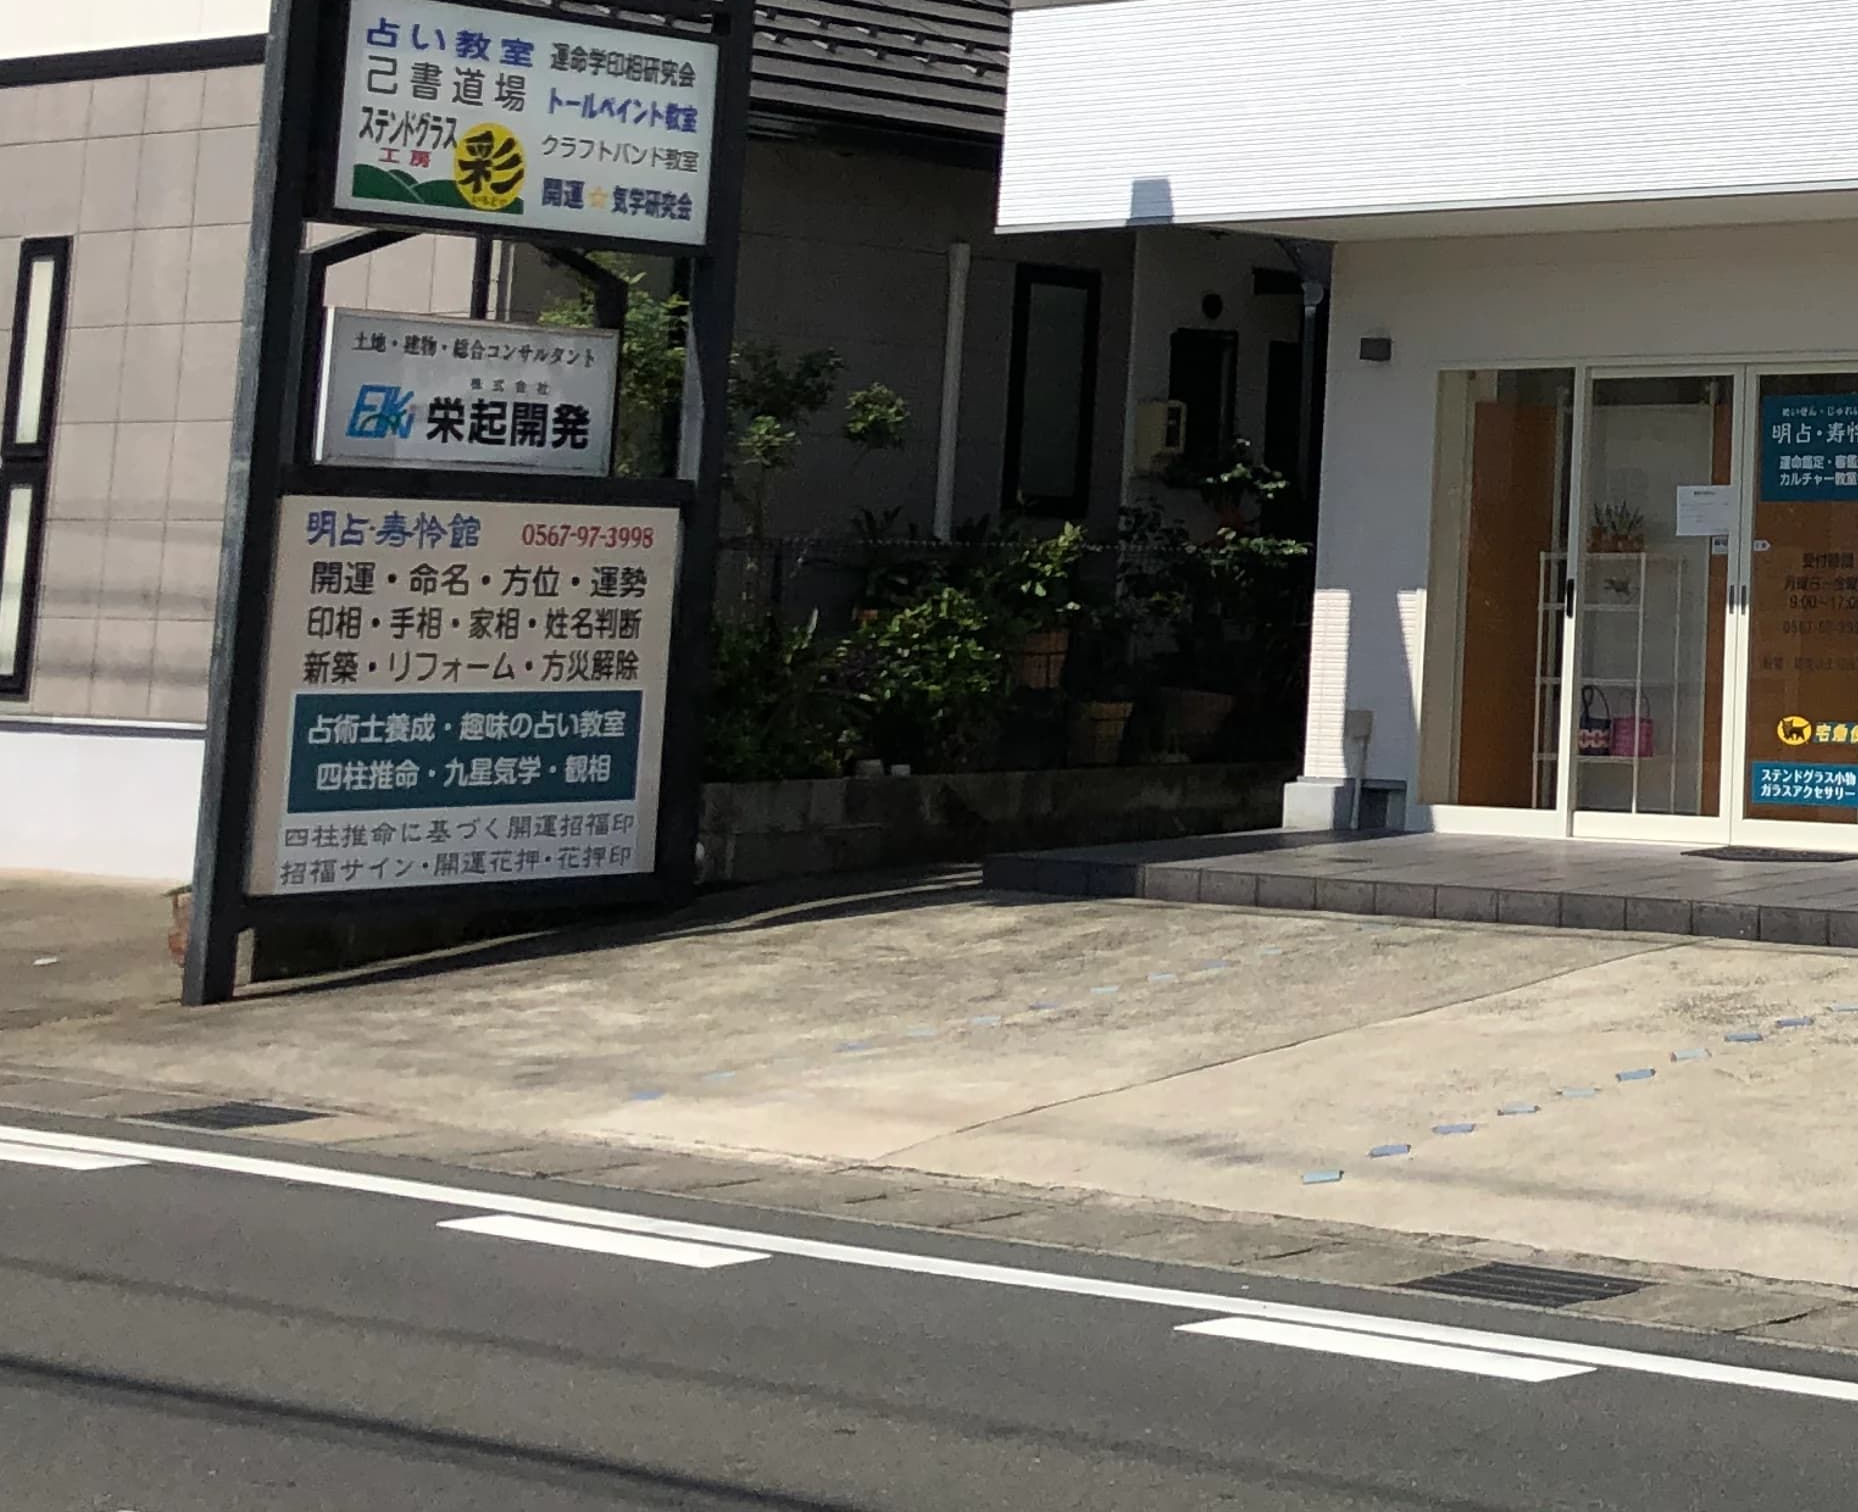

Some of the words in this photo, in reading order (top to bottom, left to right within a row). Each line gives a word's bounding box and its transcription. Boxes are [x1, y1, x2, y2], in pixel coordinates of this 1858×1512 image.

[366, 17, 535, 68] 占い教室
[366, 55, 526, 112] 己書道場
[359, 106, 458, 150] ステンドグラス
[548, 87, 698, 134] トールペイント教室
[378, 147, 432, 168] 工房
[457, 130, 525, 194] 彩
[542, 135, 699, 173] クラフトバンド教室
[470, 378, 550, 396] 株式会社
[426, 396, 592, 450] 栄起開発
[522, 523, 655, 549] 0567-97-3998
[310, 561, 648, 598] 開運・命名・方位・運勢
[307, 606, 642, 641] 印相・手相・家相・姓名判断
[303, 650, 640, 685] 新築・リフォーム・方災解除
[307, 710, 627, 745] 占術士養成・趣味の占い教室
[1760, 768, 1857, 786] ステンドグラス小物
[1760, 784, 1856, 801] ガラスアクセサリー
